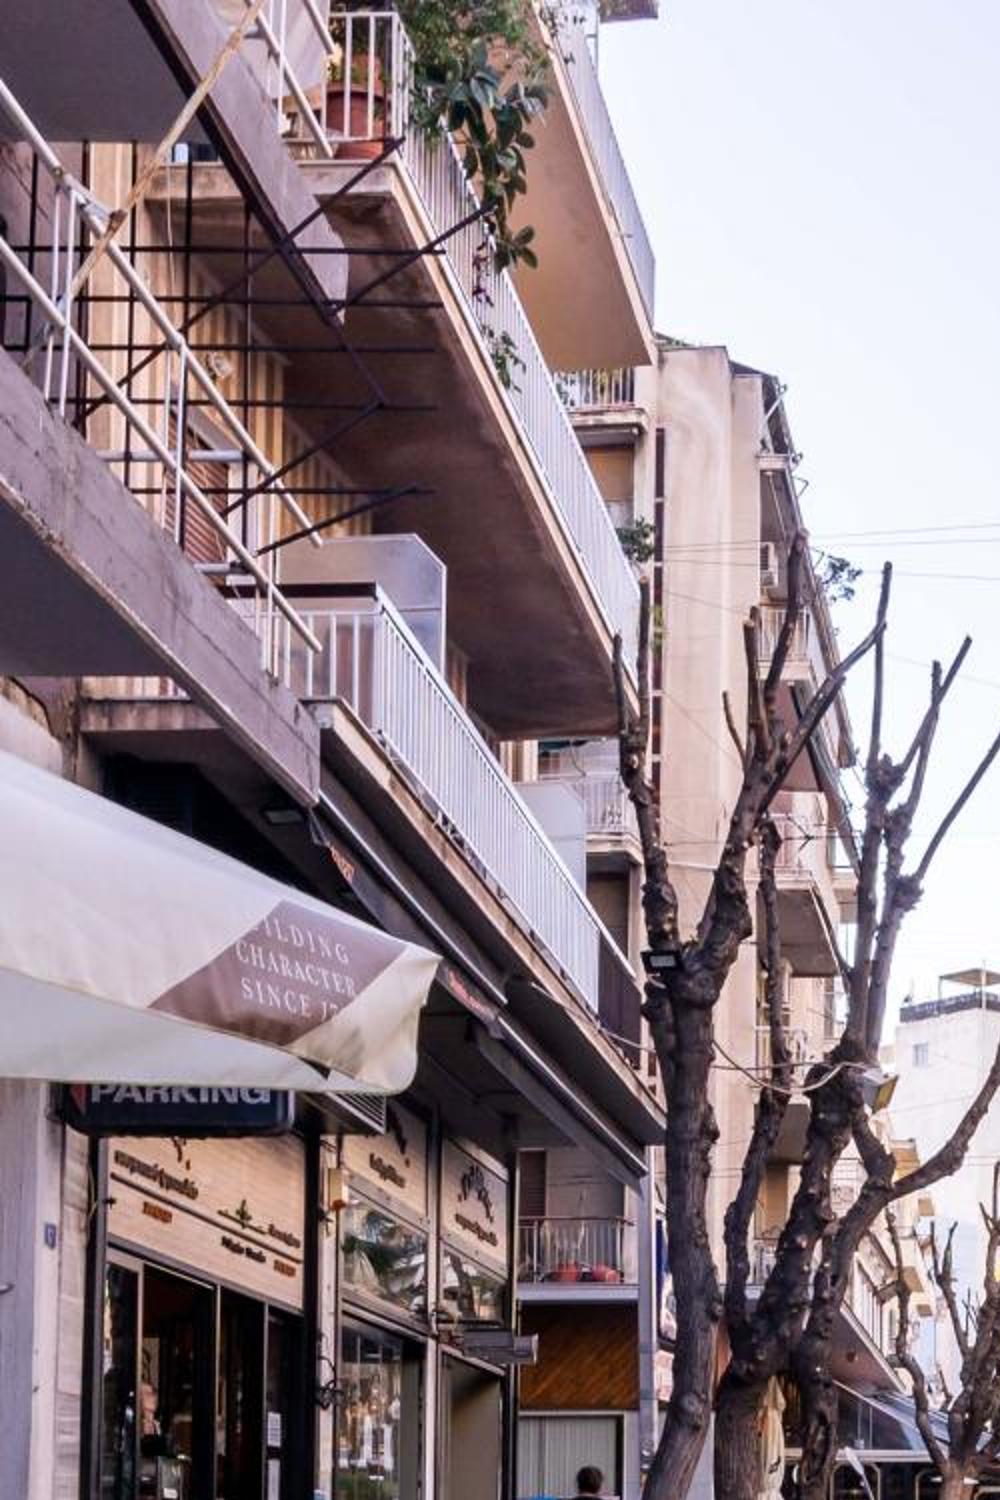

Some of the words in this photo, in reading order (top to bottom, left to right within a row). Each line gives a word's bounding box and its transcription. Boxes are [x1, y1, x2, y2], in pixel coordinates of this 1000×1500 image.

[260, 917, 349, 964] ILDING
[235, 940, 356, 997] CHARACTER
[241, 977, 312, 1017] SINCE
[91, 1084, 271, 1105] PARKING
